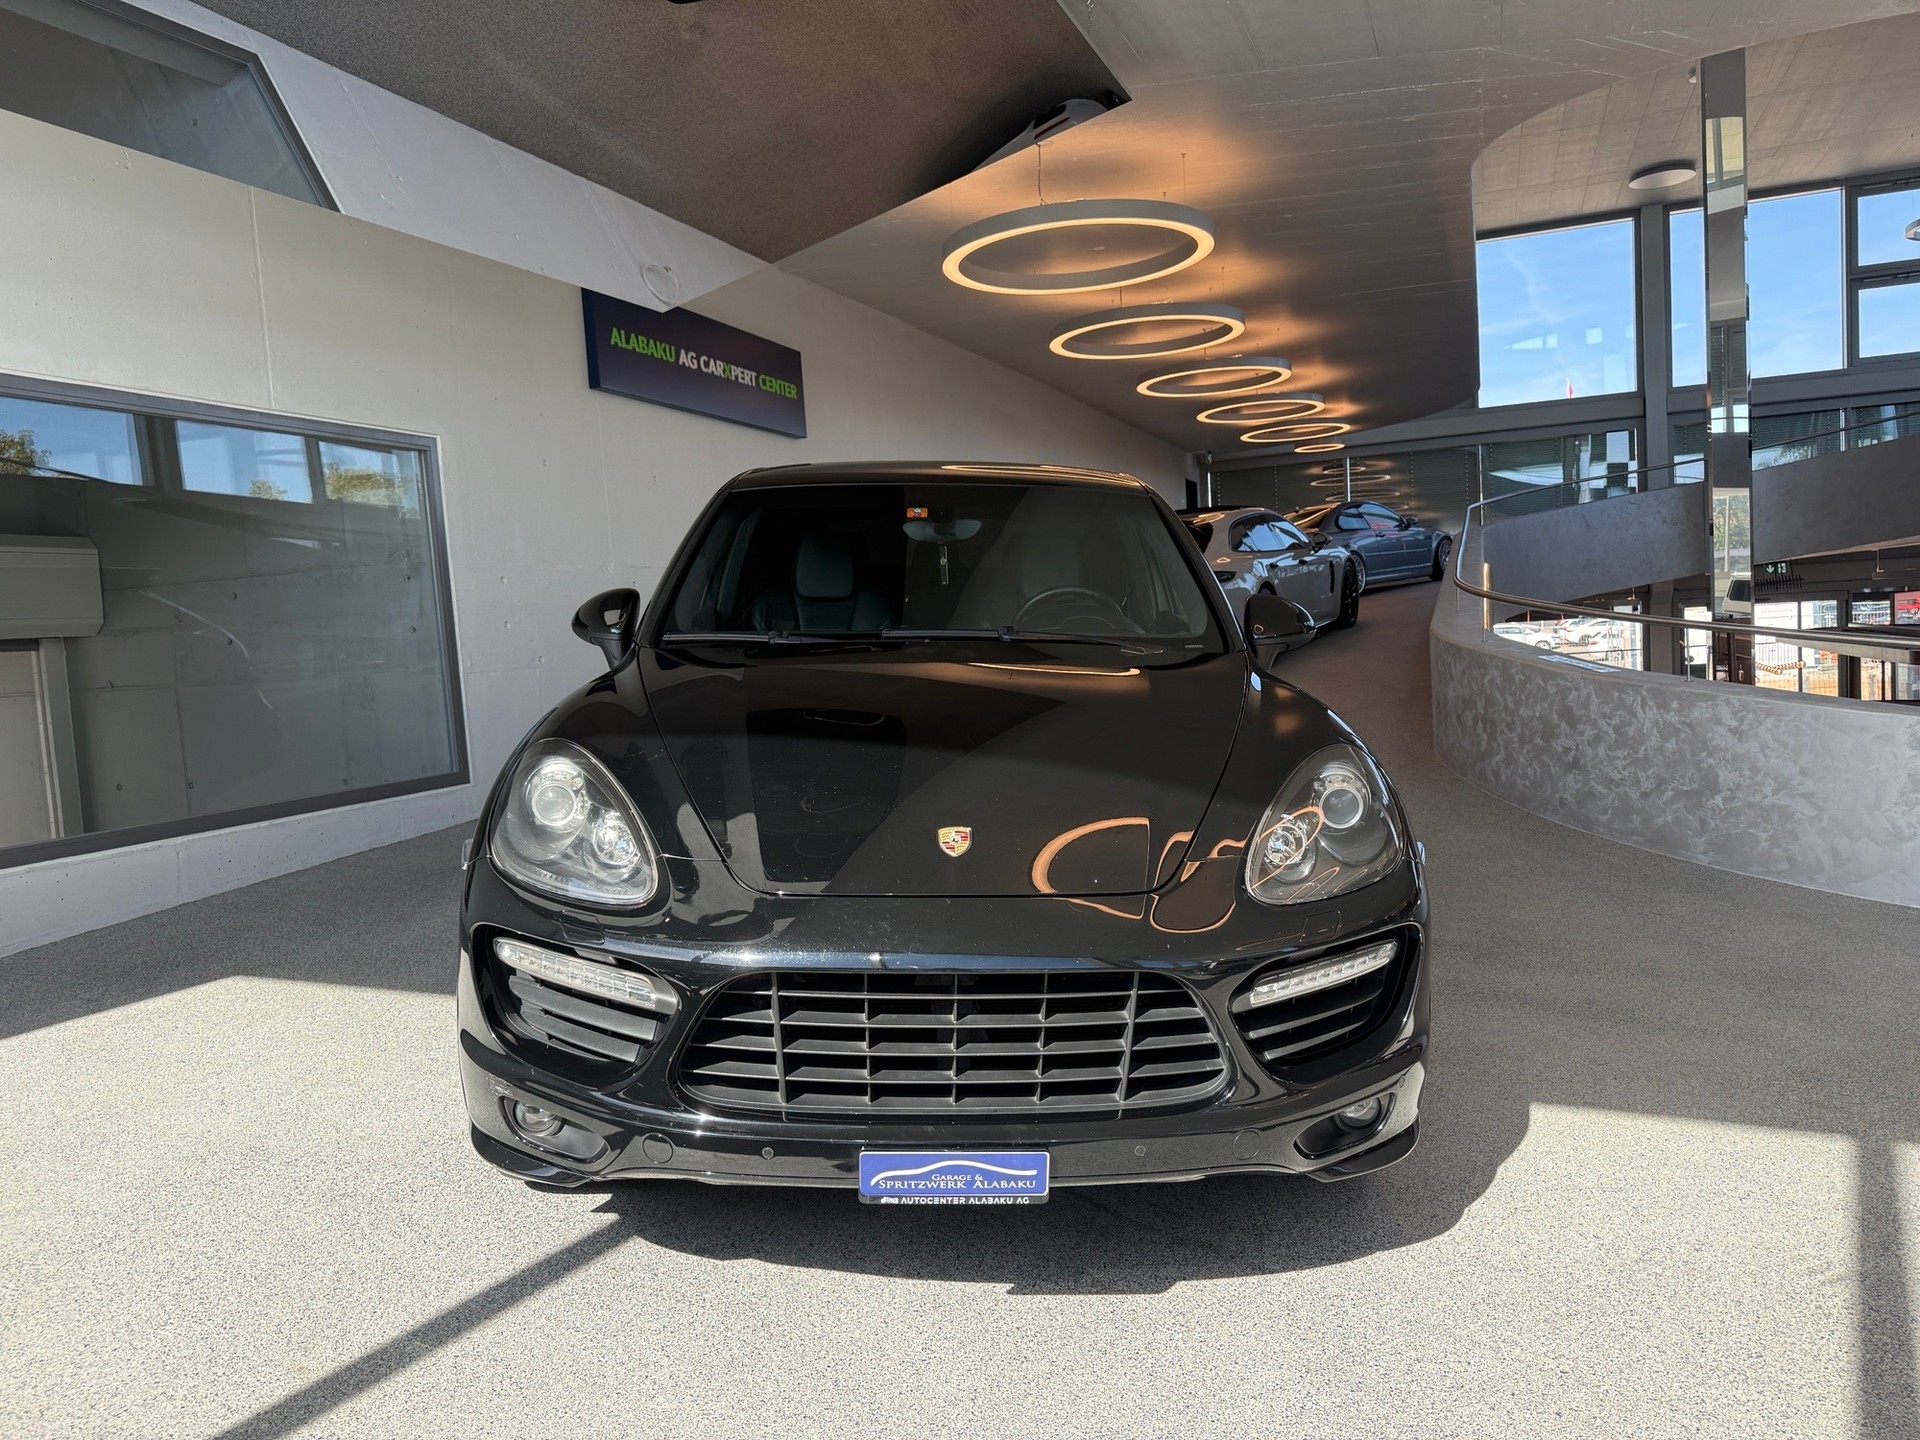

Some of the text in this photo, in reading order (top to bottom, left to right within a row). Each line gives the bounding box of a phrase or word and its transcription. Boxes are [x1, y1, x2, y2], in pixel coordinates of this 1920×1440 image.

[610, 327, 798, 400] ALABAKU AG CARXPERT CENTER
[931, 1173, 984, 1181] GARAGE &
[878, 1179, 1036, 1189] SPRITZWERK ALABAKU
[900, 1196, 1030, 1205] AUTOCENTER ALABAKU AG
